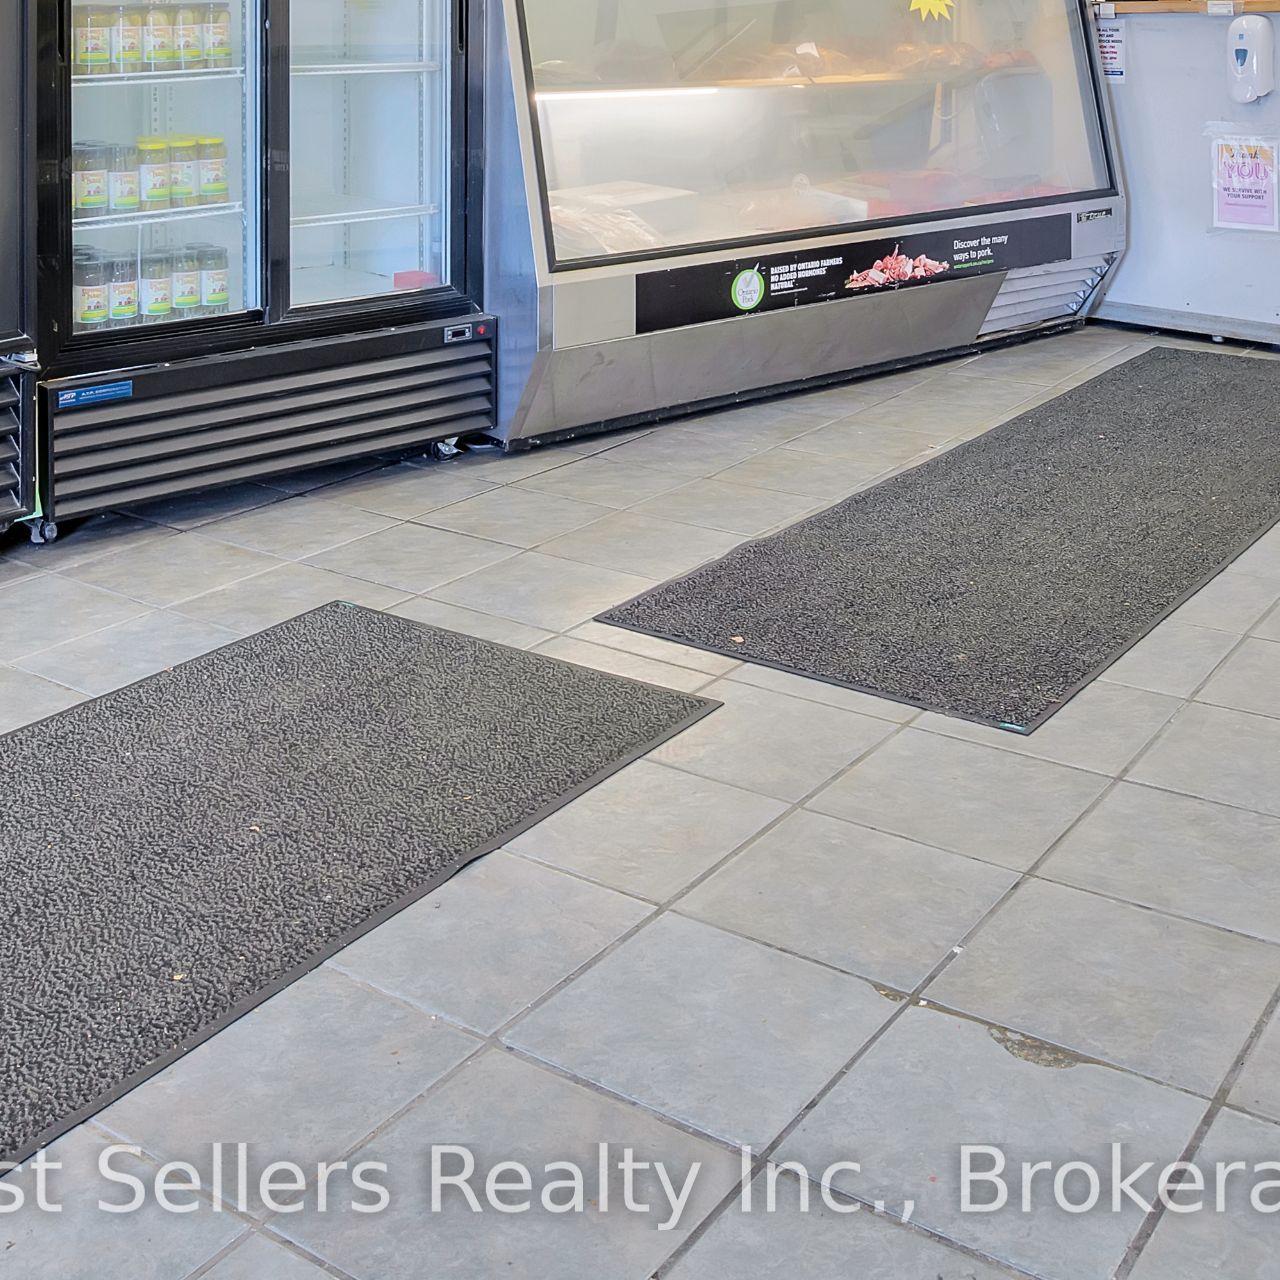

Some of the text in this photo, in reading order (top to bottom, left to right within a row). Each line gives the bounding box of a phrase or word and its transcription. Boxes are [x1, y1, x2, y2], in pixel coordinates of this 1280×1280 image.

[1224, 161, 1268, 180] YOU
[954, 234, 1008, 249] Discover the many
[954, 248, 993, 260] ways to pork.
[771, 266, 789, 274] RAISED
[798, 261, 819, 270] ONTARIO
[821, 257, 842, 267] FARMERS
[780, 272, 797, 280] ADDED
